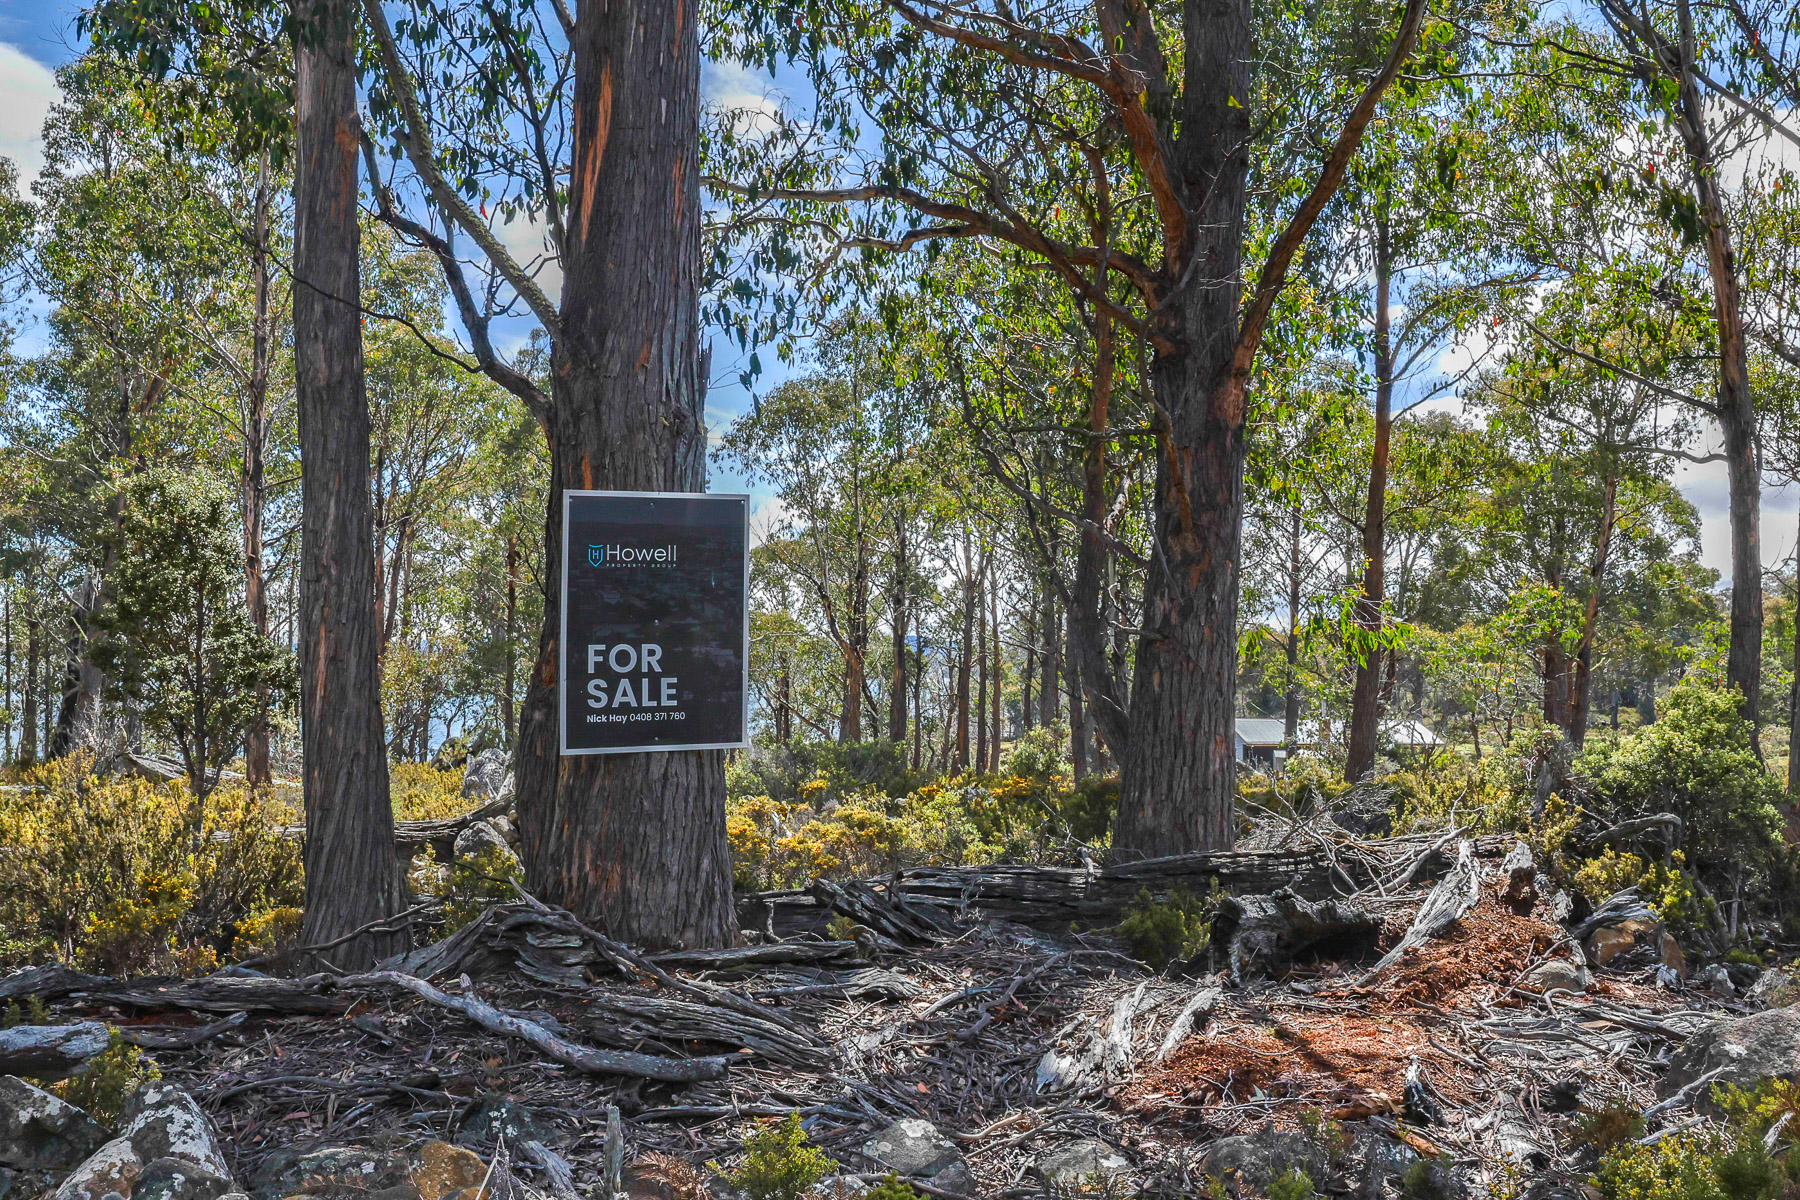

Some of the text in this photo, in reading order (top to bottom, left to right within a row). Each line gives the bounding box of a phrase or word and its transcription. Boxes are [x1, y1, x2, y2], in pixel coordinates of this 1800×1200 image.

[606, 544, 677, 562] Howell
[587, 643, 663, 674] FOR
[587, 677, 678, 709] SALE
[586, 711, 686, 724] Nick Hay 0408 371 760
